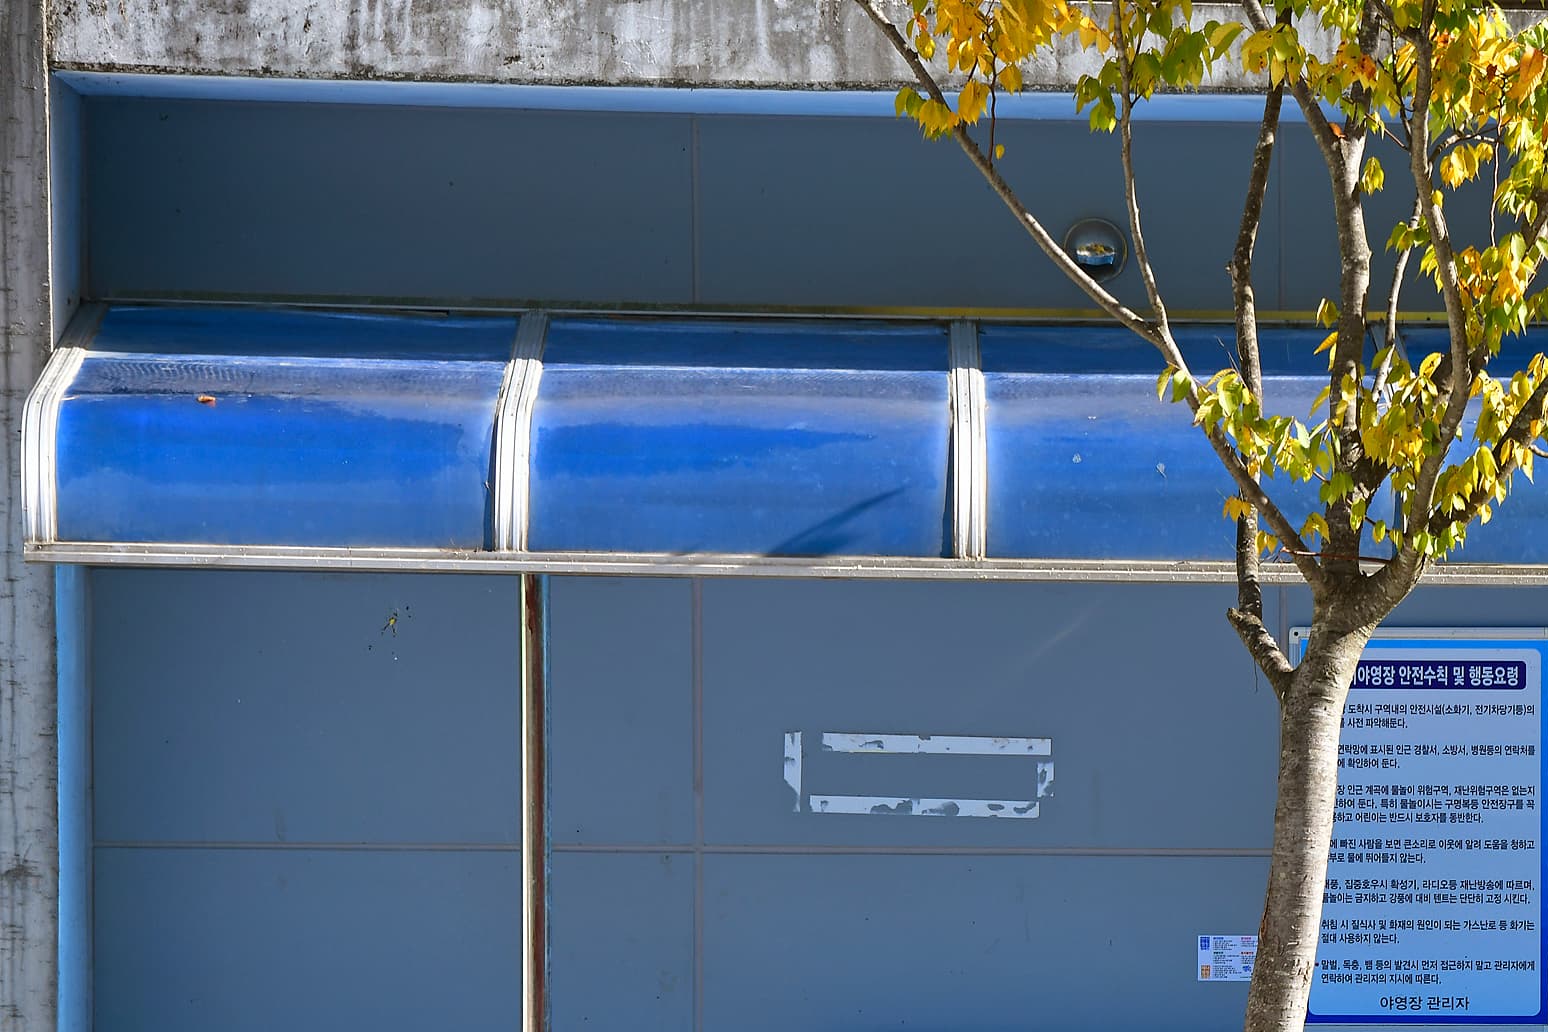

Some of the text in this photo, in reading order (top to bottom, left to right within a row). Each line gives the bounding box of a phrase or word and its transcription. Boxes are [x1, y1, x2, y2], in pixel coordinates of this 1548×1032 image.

[1353, 666, 1519, 687] 야영장 안전수칙 및 행동요령
[1348, 703, 1373, 715] 도착시
[1375, 703, 1408, 716] 구역내의
[1348, 717, 1364, 729] 사전
[1366, 717, 1408, 729] 파악해둔다.
[1338, 743, 1536, 757] 연락망에 표시된 인근 경찰서, 소방서, 병원등의 연락처를
[1348, 757, 1380, 769] 확인하여
[1382, 757, 1401, 769] 둔다.
[1348, 783, 1364, 796] 인근
[1366, 784, 1389, 796] 계곡에
[1391, 784, 1415, 797] 물놀이
[1417, 784, 1452, 797] 위험구역,
[1512, 784, 1536, 797] 없는지
[1358, 797, 1378, 810] 둔다.
[1380, 798, 1398, 810] 특히
[1482, 798, 1524, 810] 안전장구를
[1526, 799, 1536, 811] 꼭
[1355, 811, 1388, 824] 어린이는
[1390, 811, 1413, 824] 반드시
[1416, 812, 1448, 824] 보호자를
[1449, 812, 1484, 824] 동반한다.
[1340, 838, 1357, 850] 빠진
[1359, 838, 1384, 850] 사람을
[1385, 839, 1402, 850] 보면
[1403, 838, 1437, 851] 큰소리로
[1439, 838, 1463, 851] 이웃에
[1465, 839, 1482, 851] 알려
[1484, 839, 1509, 851] 도움을
[1511, 839, 1536, 851] 청하고
[1329, 851, 1346, 864] 부로
[1348, 852, 1364, 864] 물에
[1400, 852, 1426, 864] 않는다.
[1345, 878, 1388, 891] 집중호우시
[1391, 878, 1420, 891] 확성기,
[1423, 879, 1458, 891] 라디오등
[1460, 879, 1504, 891] 재난방송에
[1506, 879, 1535, 891] 따르며,
[1355, 892, 1388, 904] 금지하고
[1389, 892, 1413, 905] 강풍에
[1416, 892, 1431, 905] 대비
[1434, 892, 1458, 904] 텐트는
[1460, 892, 1484, 905] 단단히
[1486, 892, 1502, 905] 고정
[1504, 892, 1531, 905] 시킨다.
[1322, 918, 1536, 932] 취침 시 질식사 및 화재의 원인이 되는 가스난로 등 화기는
[1321, 932, 1400, 945] 절대 사용하지 않는다.
[1343, 959, 1362, 971] 독충,
[1376, 959, 1392, 971] 등의
[1394, 959, 1419, 971] 발견시
[1422, 959, 1438, 971] 먼저
[1441, 959, 1474, 972] 접근하지
[1476, 959, 1493, 972] 말고
[1494, 959, 1536, 972] 관리자에게
[1321, 972, 1442, 985] 연락하여 관리자의 지시에 따른다.
[1380, 995, 1470, 1011] 야영장 관리자
